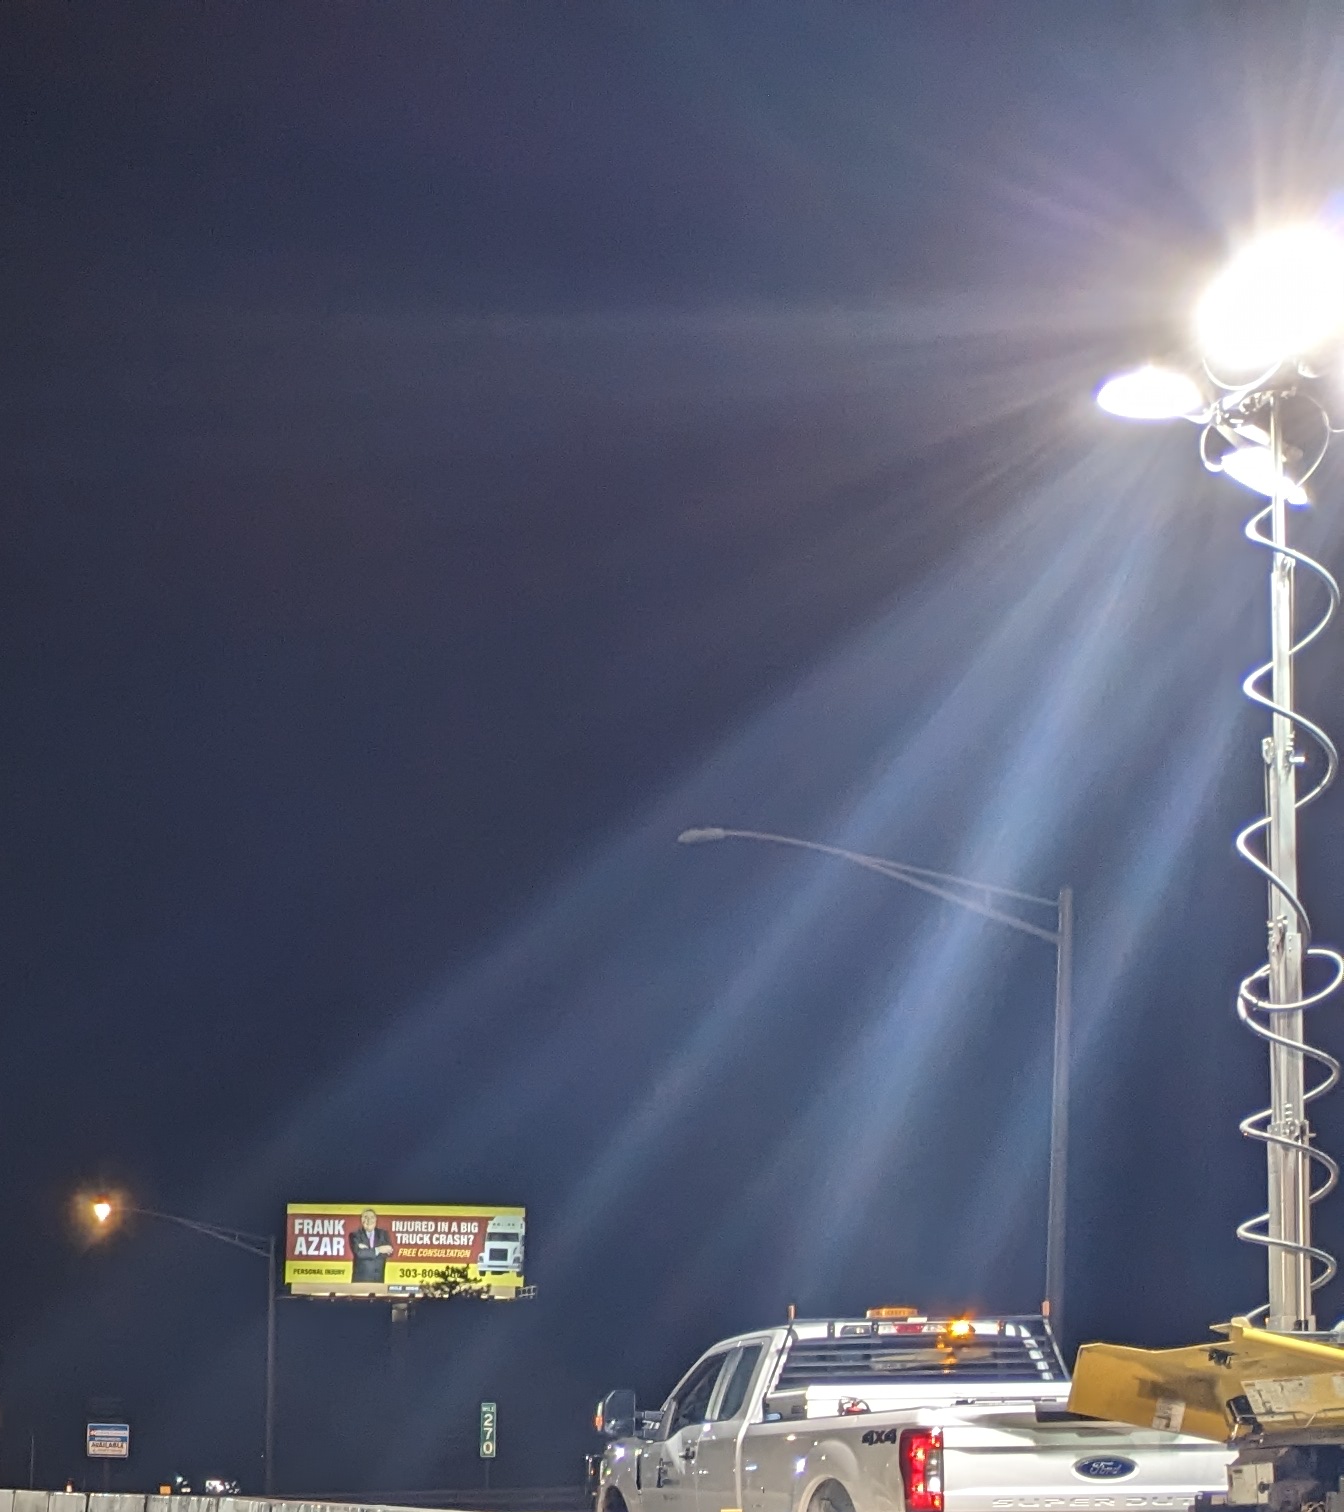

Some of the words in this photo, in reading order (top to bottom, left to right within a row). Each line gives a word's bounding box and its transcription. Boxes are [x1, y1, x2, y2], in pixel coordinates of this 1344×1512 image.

[294, 1219, 345, 1235] FRANK
[392, 1220, 434, 1232] INJURED
[437, 1221, 449, 1232] IN
[450, 1222, 458, 1232] A
[460, 1222, 479, 1233] BIG
[396, 1233, 431, 1245] TRUCK
[433, 1234, 475, 1245] CRASH?
[294, 1236, 345, 1256] AZAR
[398, 1248, 417, 1257] FREE
[417, 1248, 471, 1258] CONSULTATION
[293, 1268, 323, 1276] PERSONAL
[1089, 1460, 1122, 1476] Ford
[992, 1498, 1115, 1508] SUPER
